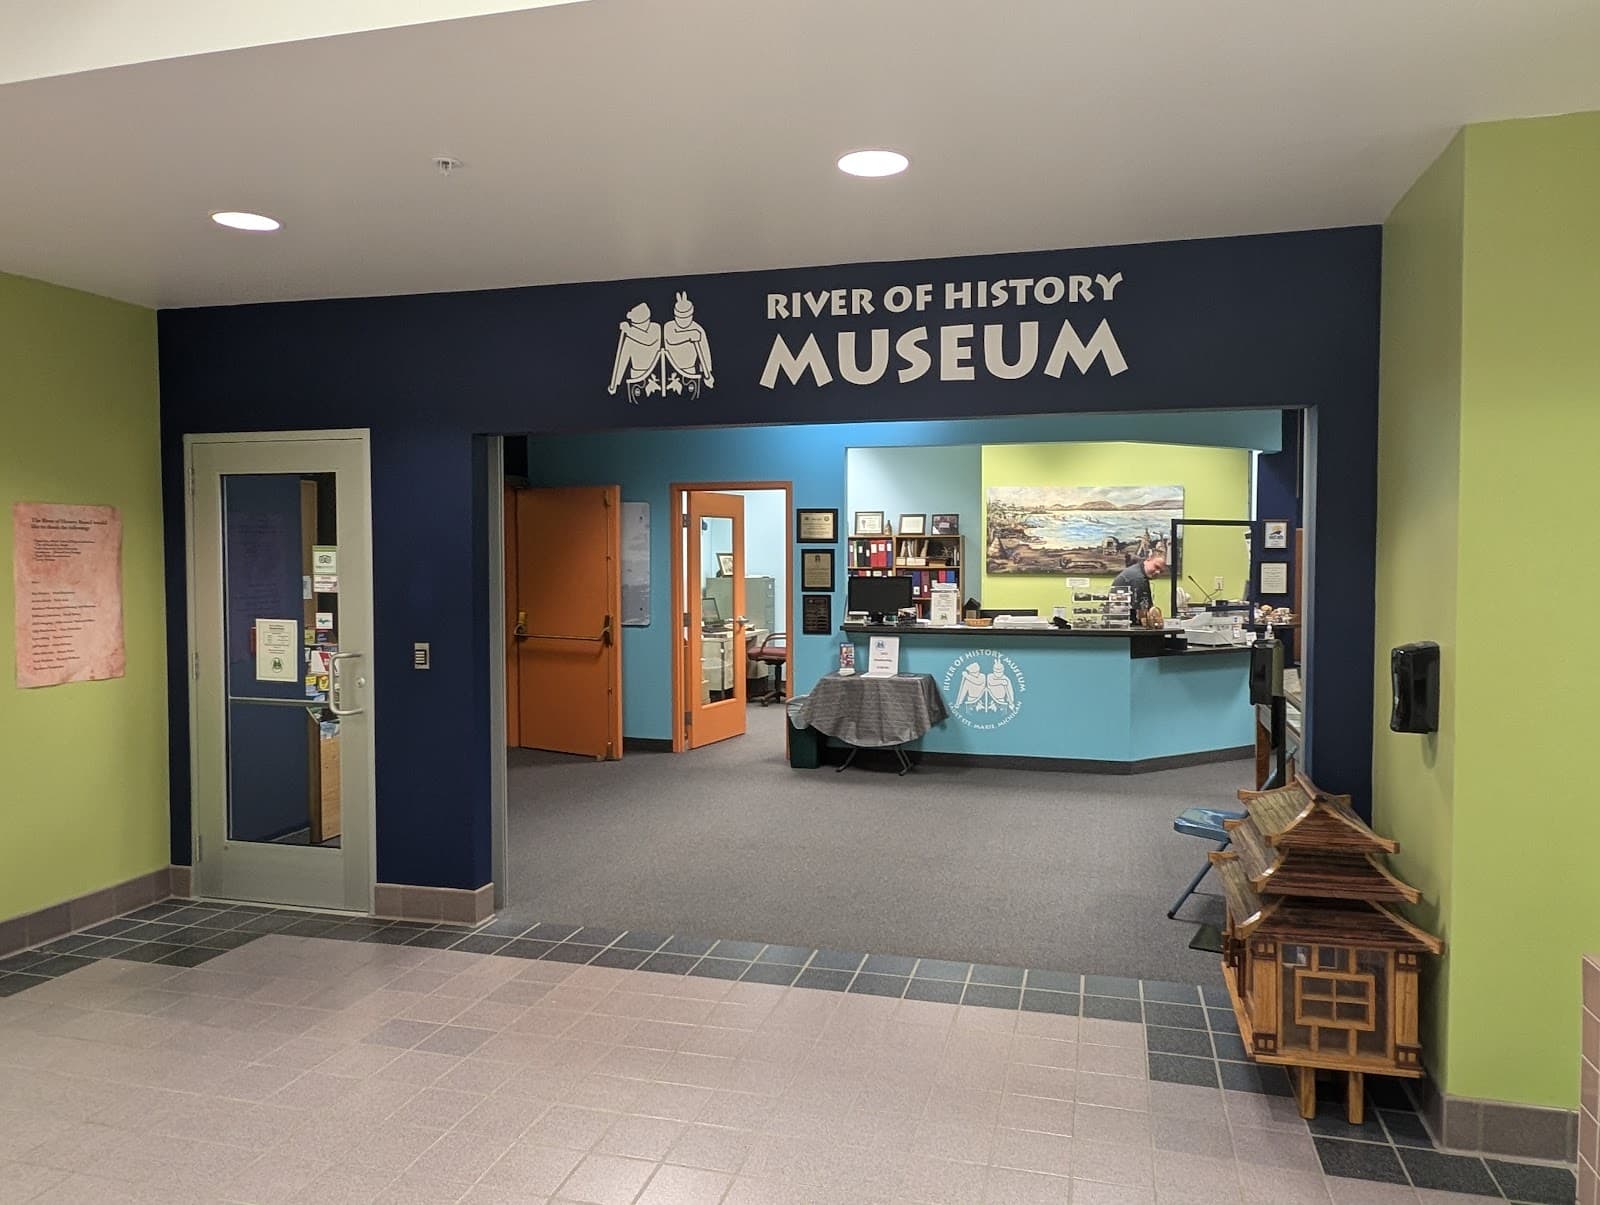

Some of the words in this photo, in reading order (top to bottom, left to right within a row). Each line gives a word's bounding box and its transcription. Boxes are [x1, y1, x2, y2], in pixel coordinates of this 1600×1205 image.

[767, 289, 874, 320] RIVER
[884, 284, 932, 313] OF
[944, 272, 1123, 310] HISTORY
[760, 318, 1128, 388] MUSEUM
[943, 666, 956, 691] RIVER
[954, 656, 964, 667] OF
[965, 649, 1003, 659] HISTORY
[1003, 657, 1026, 692] MUSEUM
